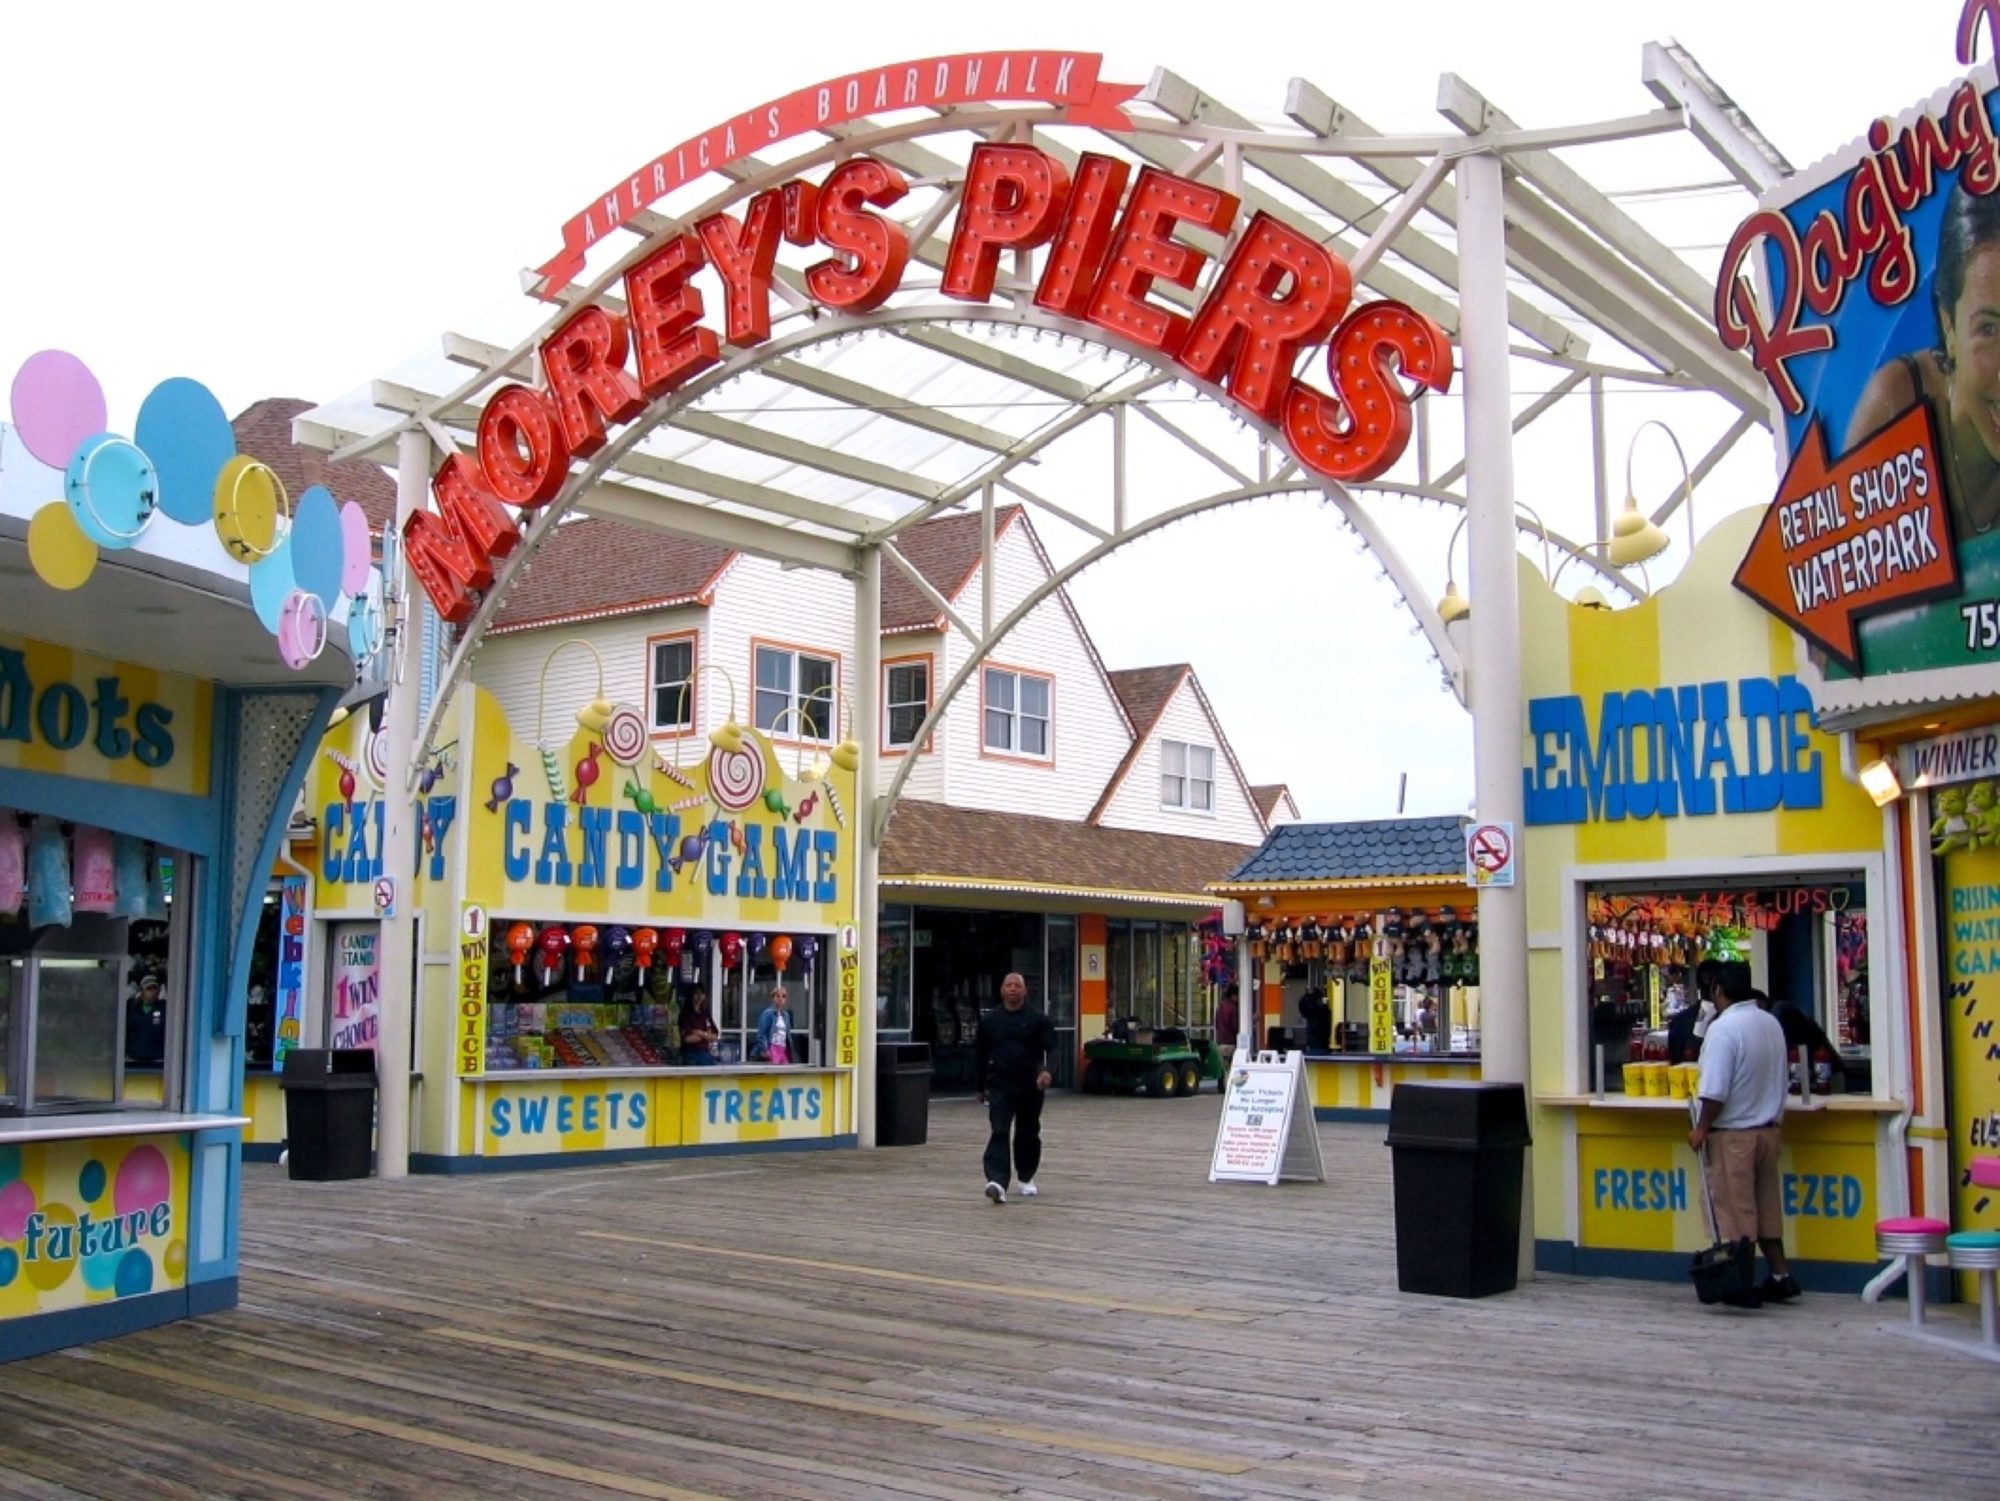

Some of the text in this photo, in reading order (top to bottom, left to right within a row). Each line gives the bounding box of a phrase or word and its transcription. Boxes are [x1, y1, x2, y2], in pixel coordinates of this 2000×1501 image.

[583, 56, 1076, 244] AMERICA'S BOARDWALK
[1714, 80, 2000, 415] Raging
[402, 142, 1454, 622] MOREY'S PIERS
[1778, 446, 1929, 550] RETAIL SHOPS
[1787, 505, 1938, 615] WATERPARK
[1961, 601, 2000, 650] 75
[1523, 675, 1822, 826] EMONADE
[1915, 734, 1997, 778] WINNER
[504, 798, 837, 903] CANDY GAME
[341, 934, 377, 949] CANDY
[468, 908, 480, 935] 1
[845, 928, 853, 949] 1
[1953, 917, 2000, 942] WAT
[341, 951, 375, 966] STAND
[461, 937, 486, 963] WIN
[840, 951, 858, 972] WIN
[335, 971, 379, 1019] 1 WIN
[462, 963, 481, 1073] CHOICE
[842, 973, 856, 1064] CHOICE
[1374, 977, 1387, 1051] CHOICE
[333, 1014, 378, 1050] CHOICE
[490, 1087, 821, 1137] SWEETS TREATS
[1593, 1168, 1688, 1212] FRESH
[24, 1202, 170, 1260] future
